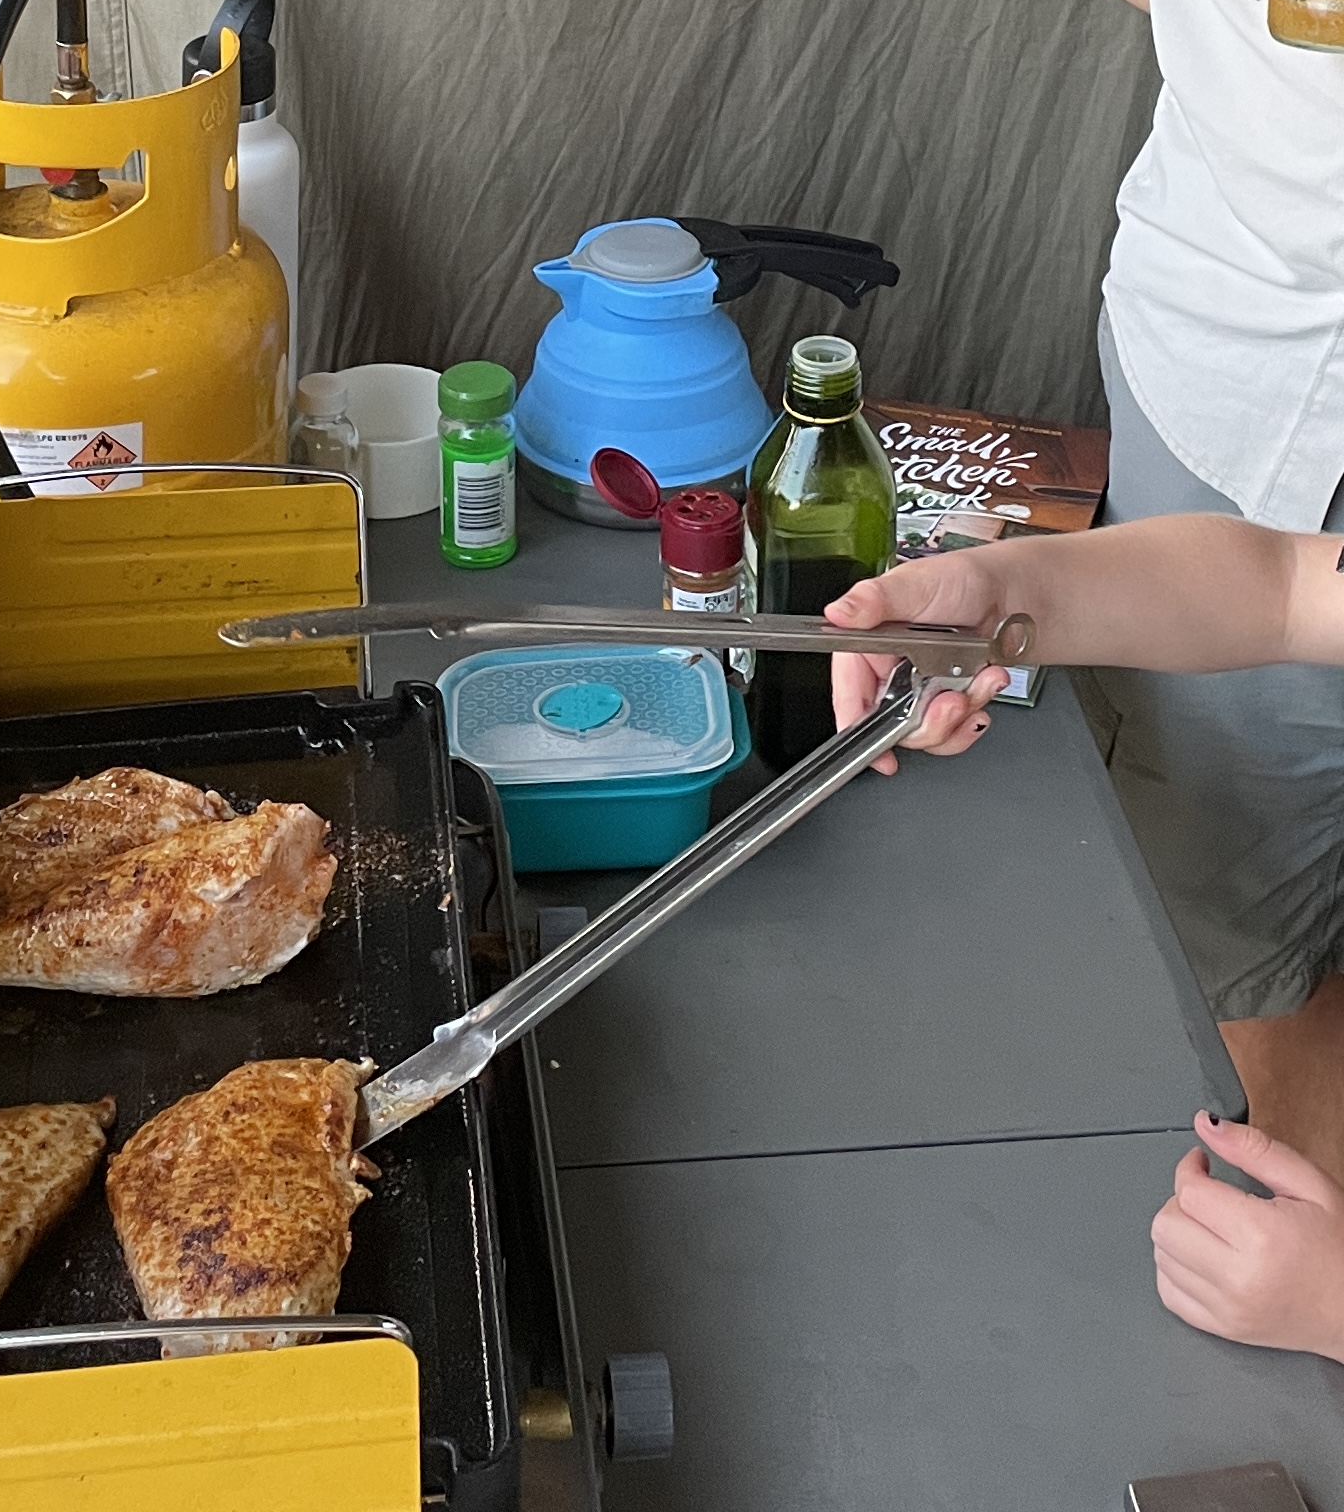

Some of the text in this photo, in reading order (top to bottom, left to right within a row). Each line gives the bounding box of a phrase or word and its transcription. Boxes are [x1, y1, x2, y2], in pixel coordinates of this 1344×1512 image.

[879, 422, 1010, 460] Small
[928, 425, 966, 438] THE
[891, 454, 1017, 489] tchen
